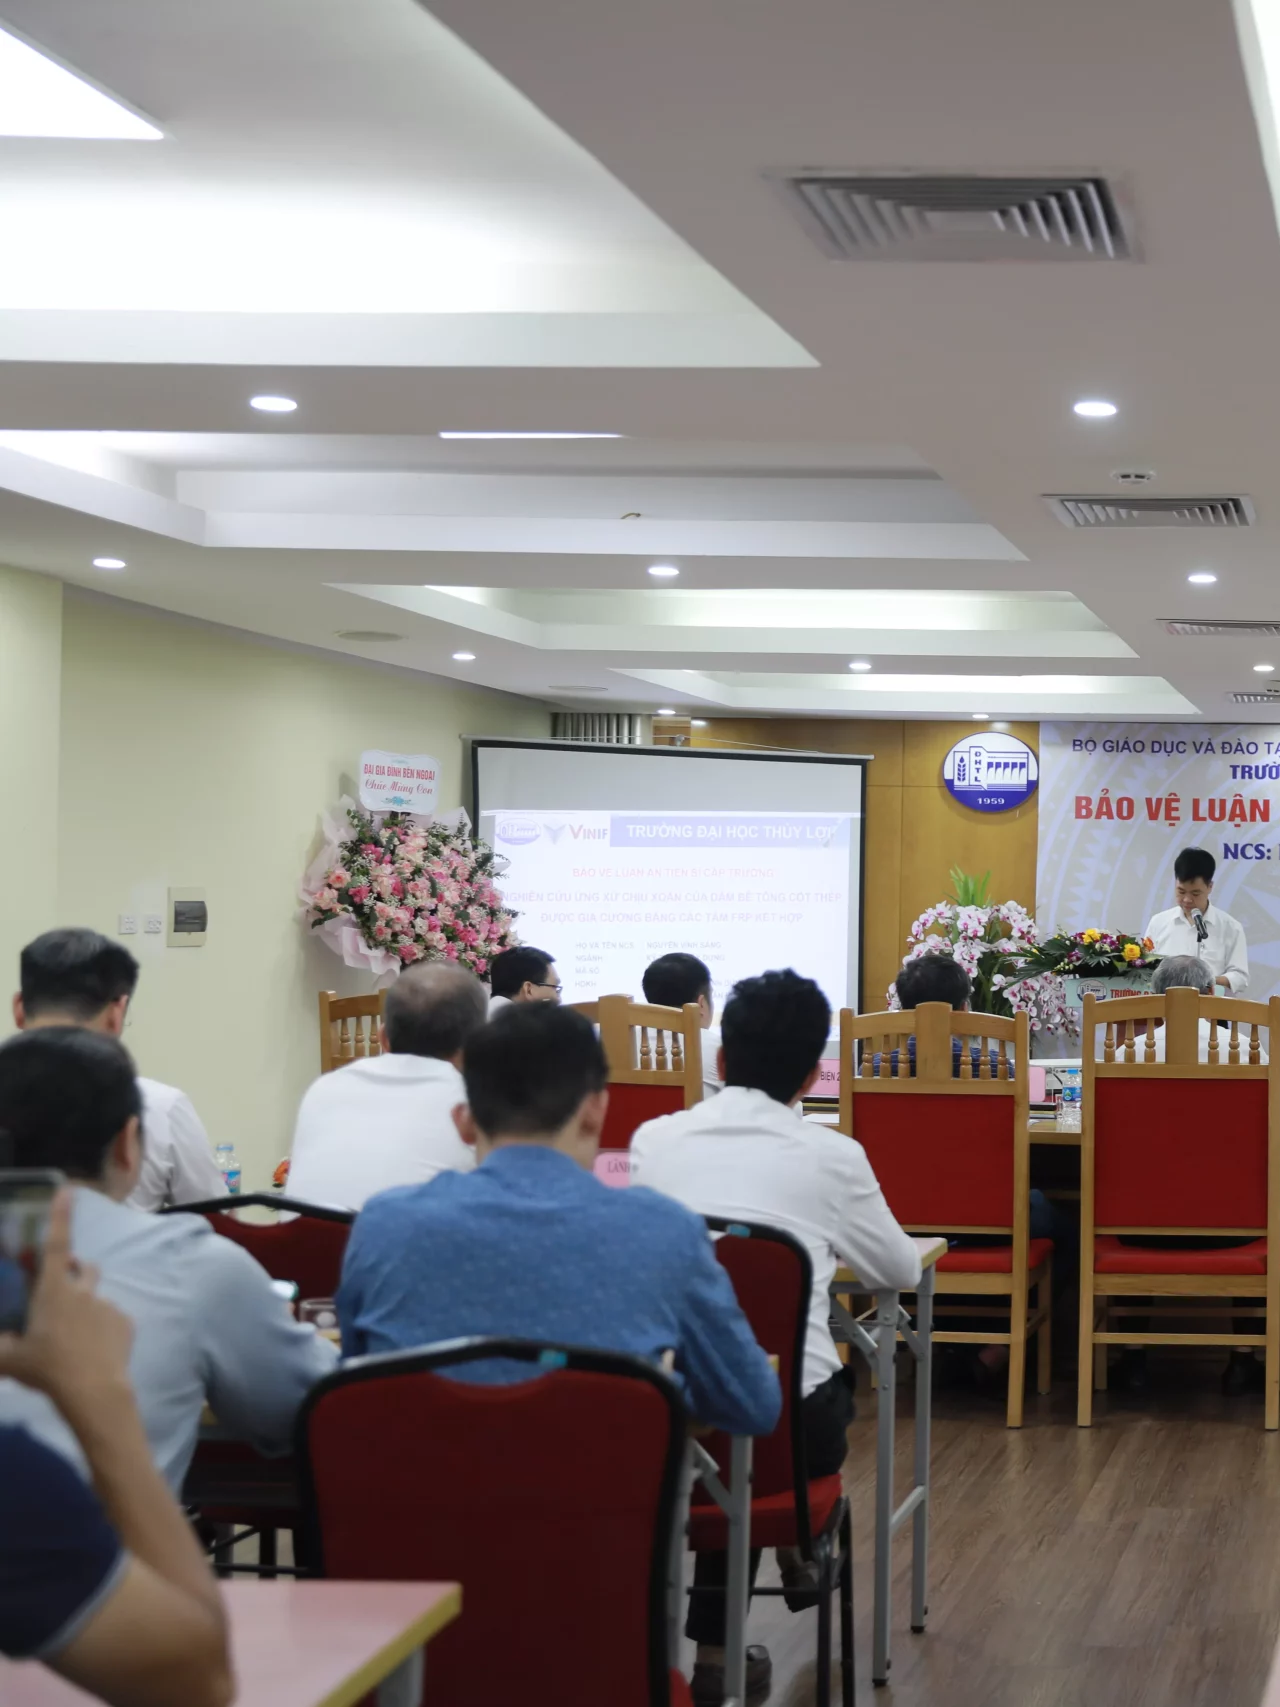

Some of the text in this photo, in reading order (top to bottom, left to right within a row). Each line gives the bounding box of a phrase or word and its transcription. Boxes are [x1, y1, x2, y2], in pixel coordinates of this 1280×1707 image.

[1072, 737, 1097, 756] BỘ
[1102, 736, 1145, 753] GIÁO
[1151, 740, 1187, 757] DỤC
[1192, 738, 1216, 754] VÀ
[1221, 738, 1259, 755] ĐÀO
[375, 765, 385, 776] GIA
[416, 769, 435, 783] NGOẠI
[365, 778, 387, 791] Chúc
[417, 784, 433, 794] Con
[977, 797, 1005, 805] 1959
[1074, 788, 1135, 821] BẢO
[1145, 792, 1181, 827] VỆ
[1192, 793, 1270, 828] LUẬN
[626, 821, 693, 838] TRƯỜNG
[697, 825, 722, 841] ĐẠI
[726, 825, 759, 841] HỌC
[806, 825, 832, 841] LỢI
[1223, 843, 1272, 860] NCS:
